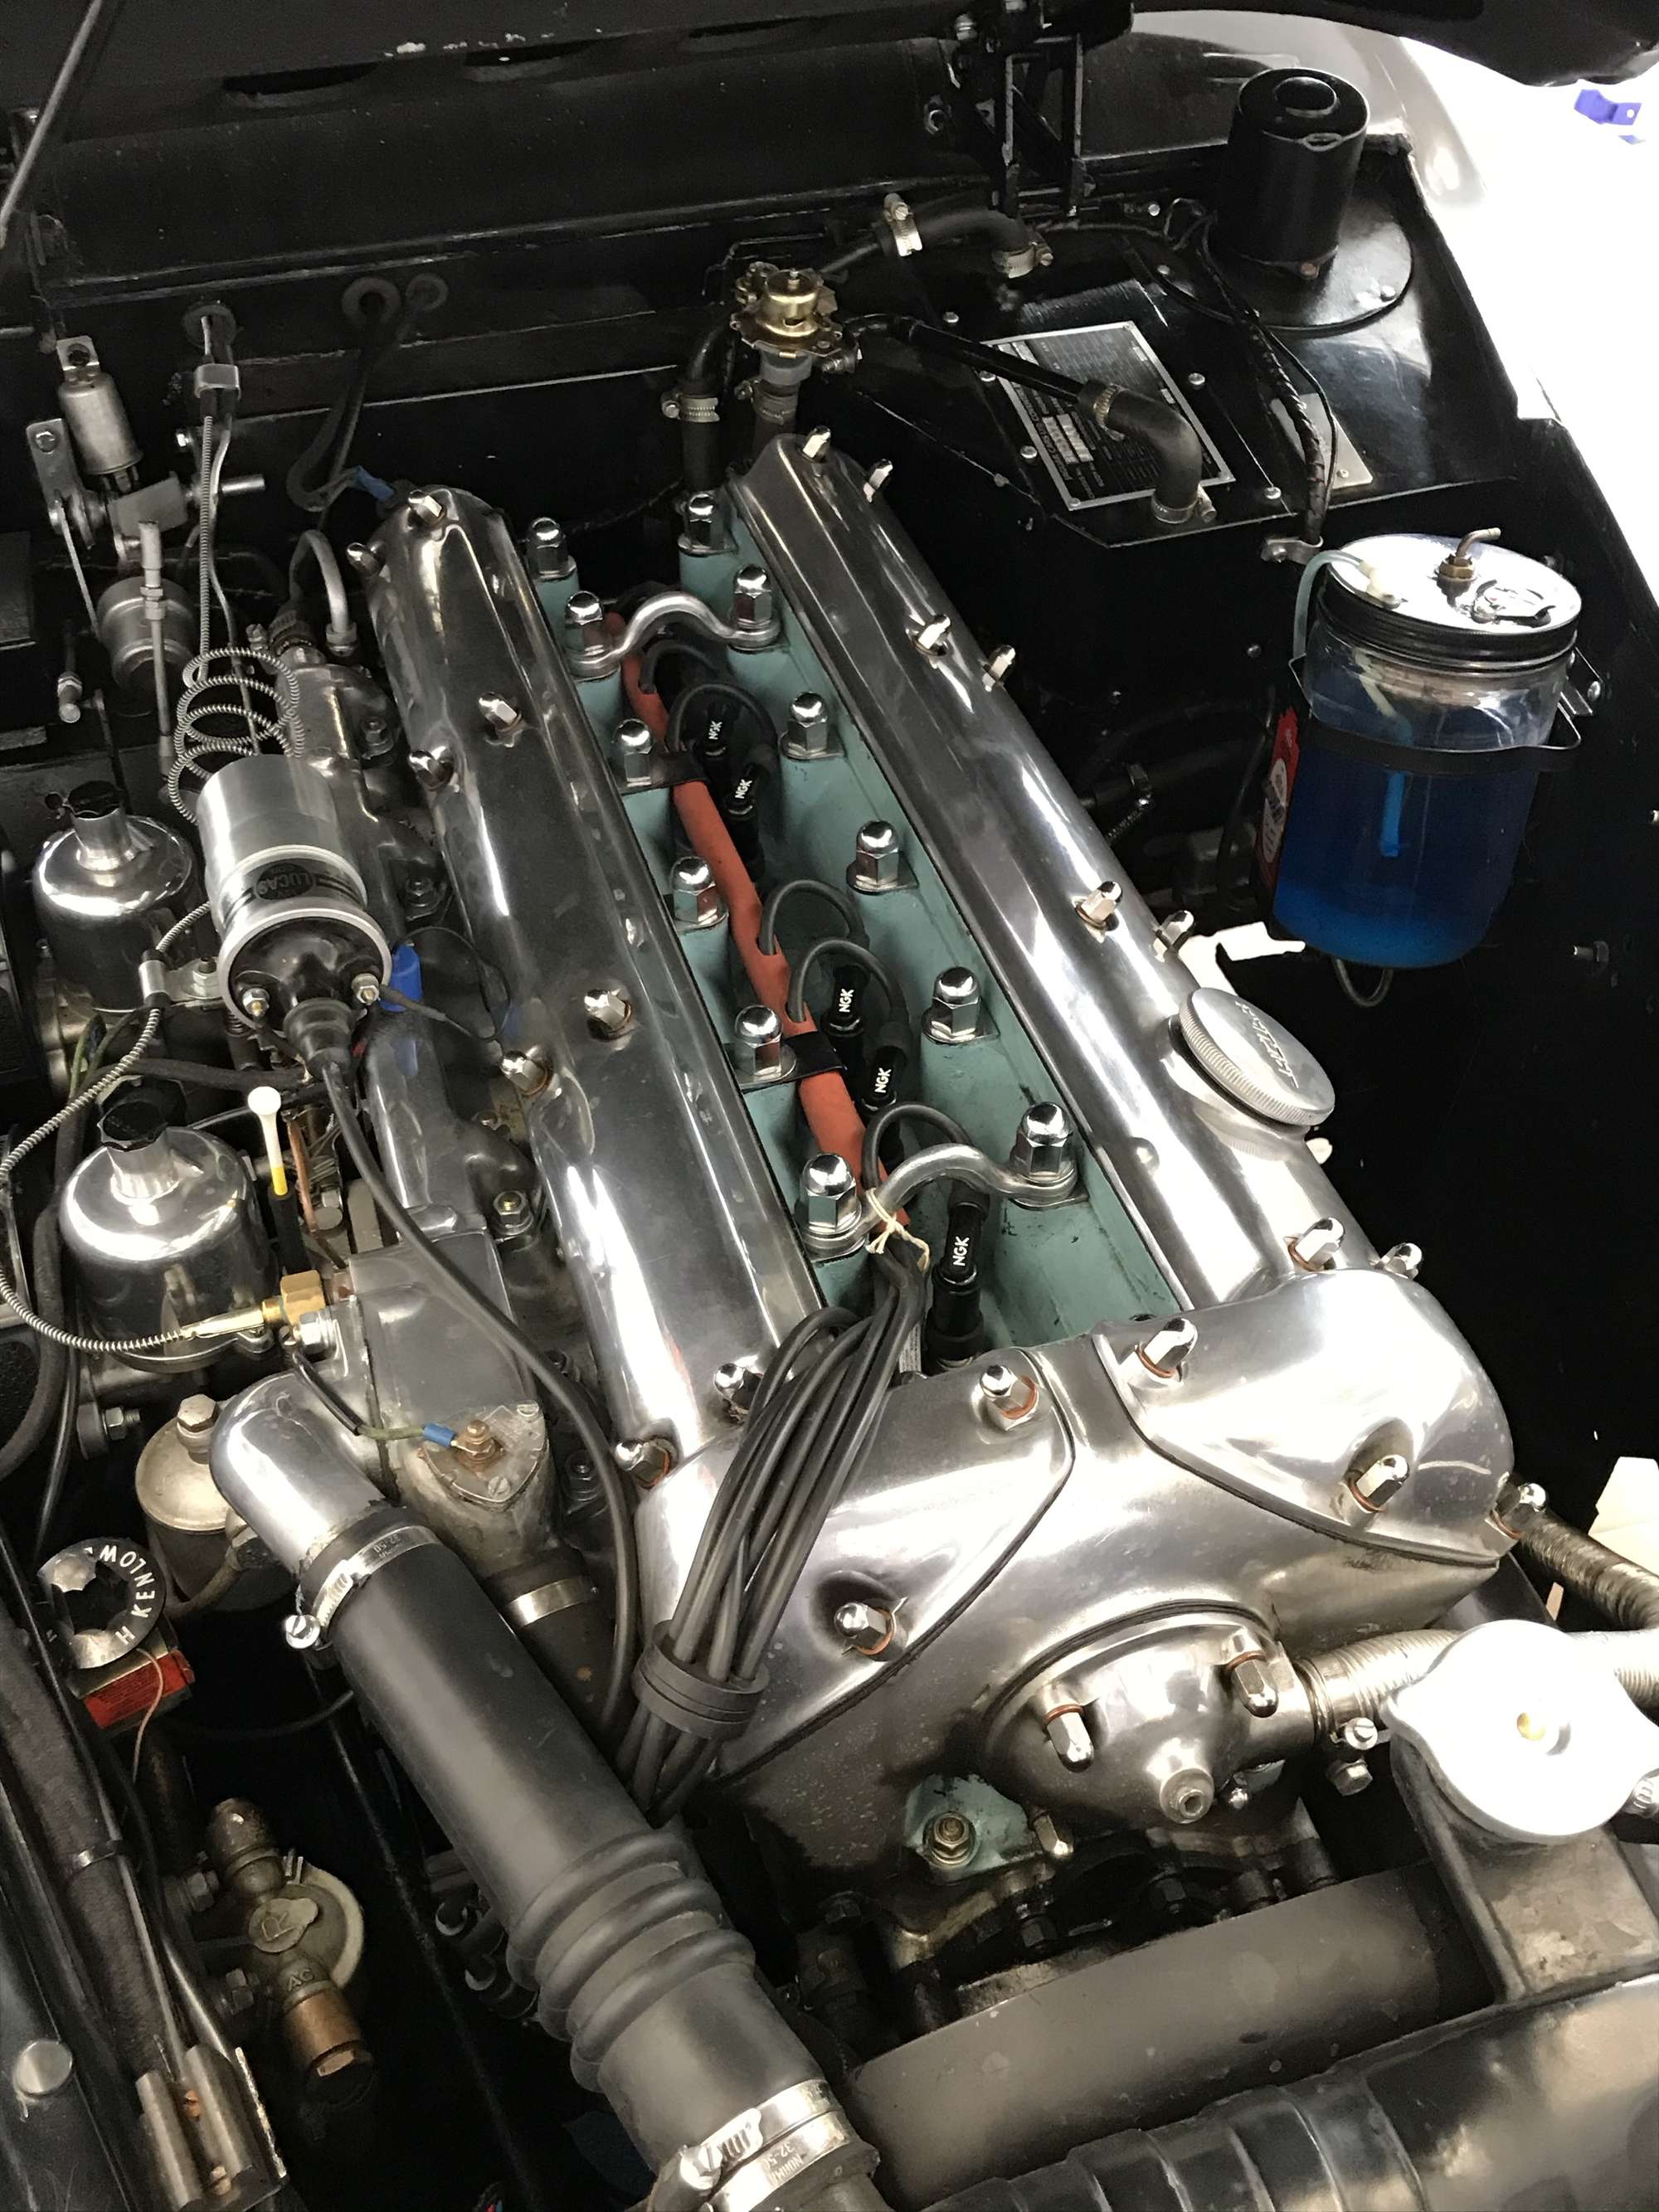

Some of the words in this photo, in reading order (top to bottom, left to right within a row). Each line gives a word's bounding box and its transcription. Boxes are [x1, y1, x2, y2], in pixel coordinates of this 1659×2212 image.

[708, 720, 722, 741] NGK
[734, 779, 753, 800] NGK
[257, 873, 310, 893] LUCAS
[838, 988, 854, 1014] NGK
[873, 1067, 892, 1094] NGK
[951, 1236, 970, 1266] NGK
[289, 1969, 313, 1990] AC
